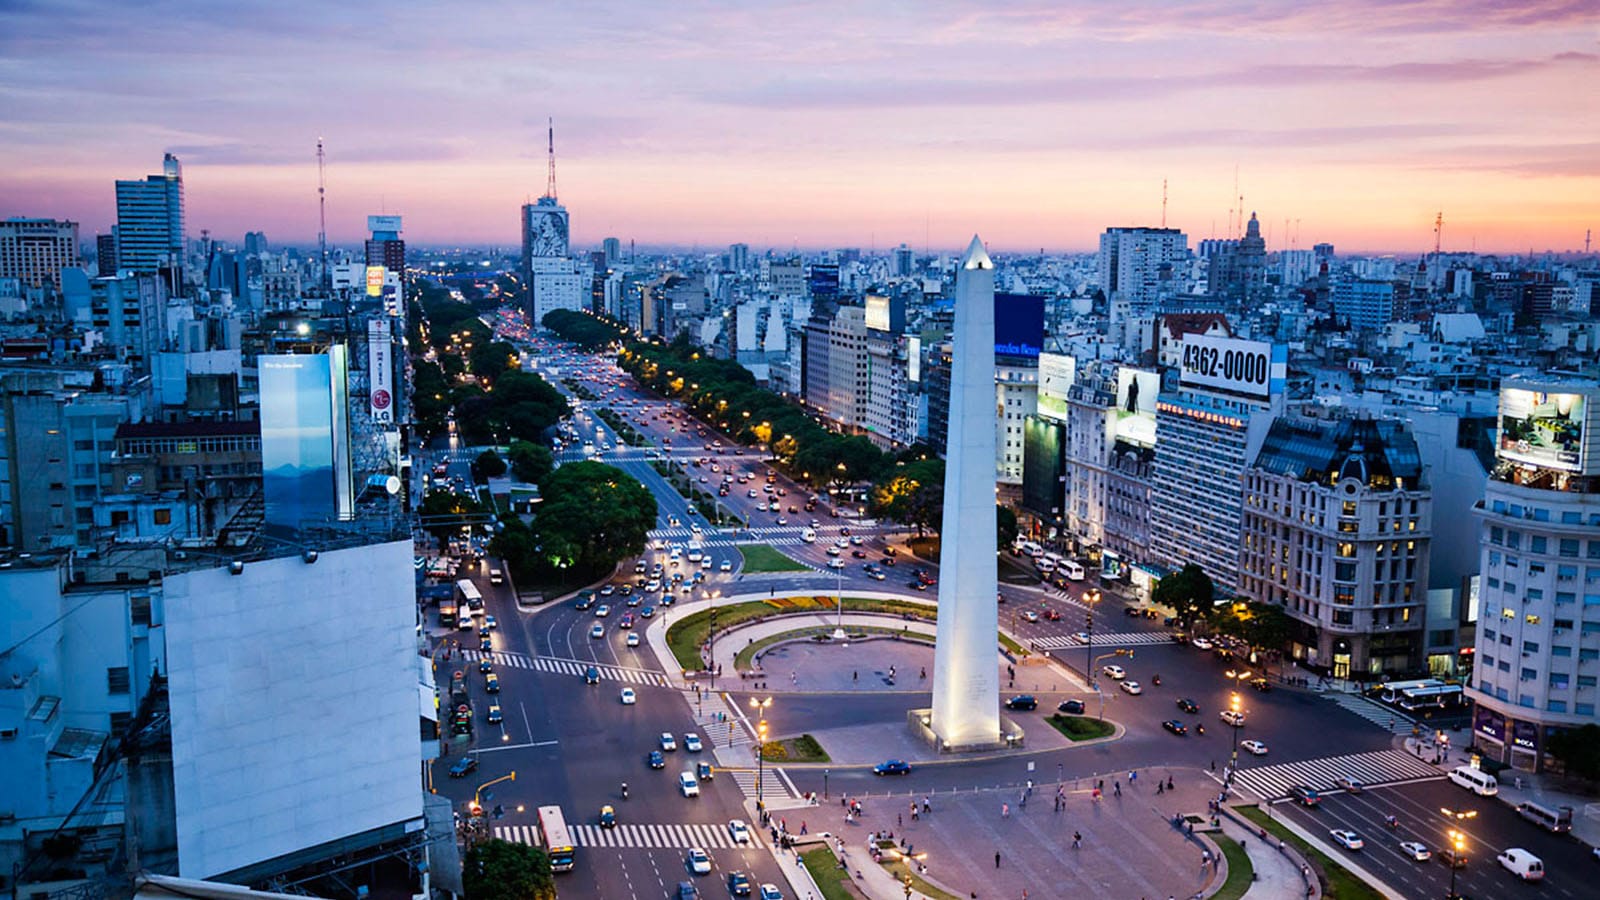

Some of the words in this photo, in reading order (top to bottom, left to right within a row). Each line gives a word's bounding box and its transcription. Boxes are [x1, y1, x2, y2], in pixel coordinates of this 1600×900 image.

[1183, 344, 1266, 384] 4362-0000
[1156, 402, 1184, 414] HOTEL
[374, 411, 390, 421] LG
